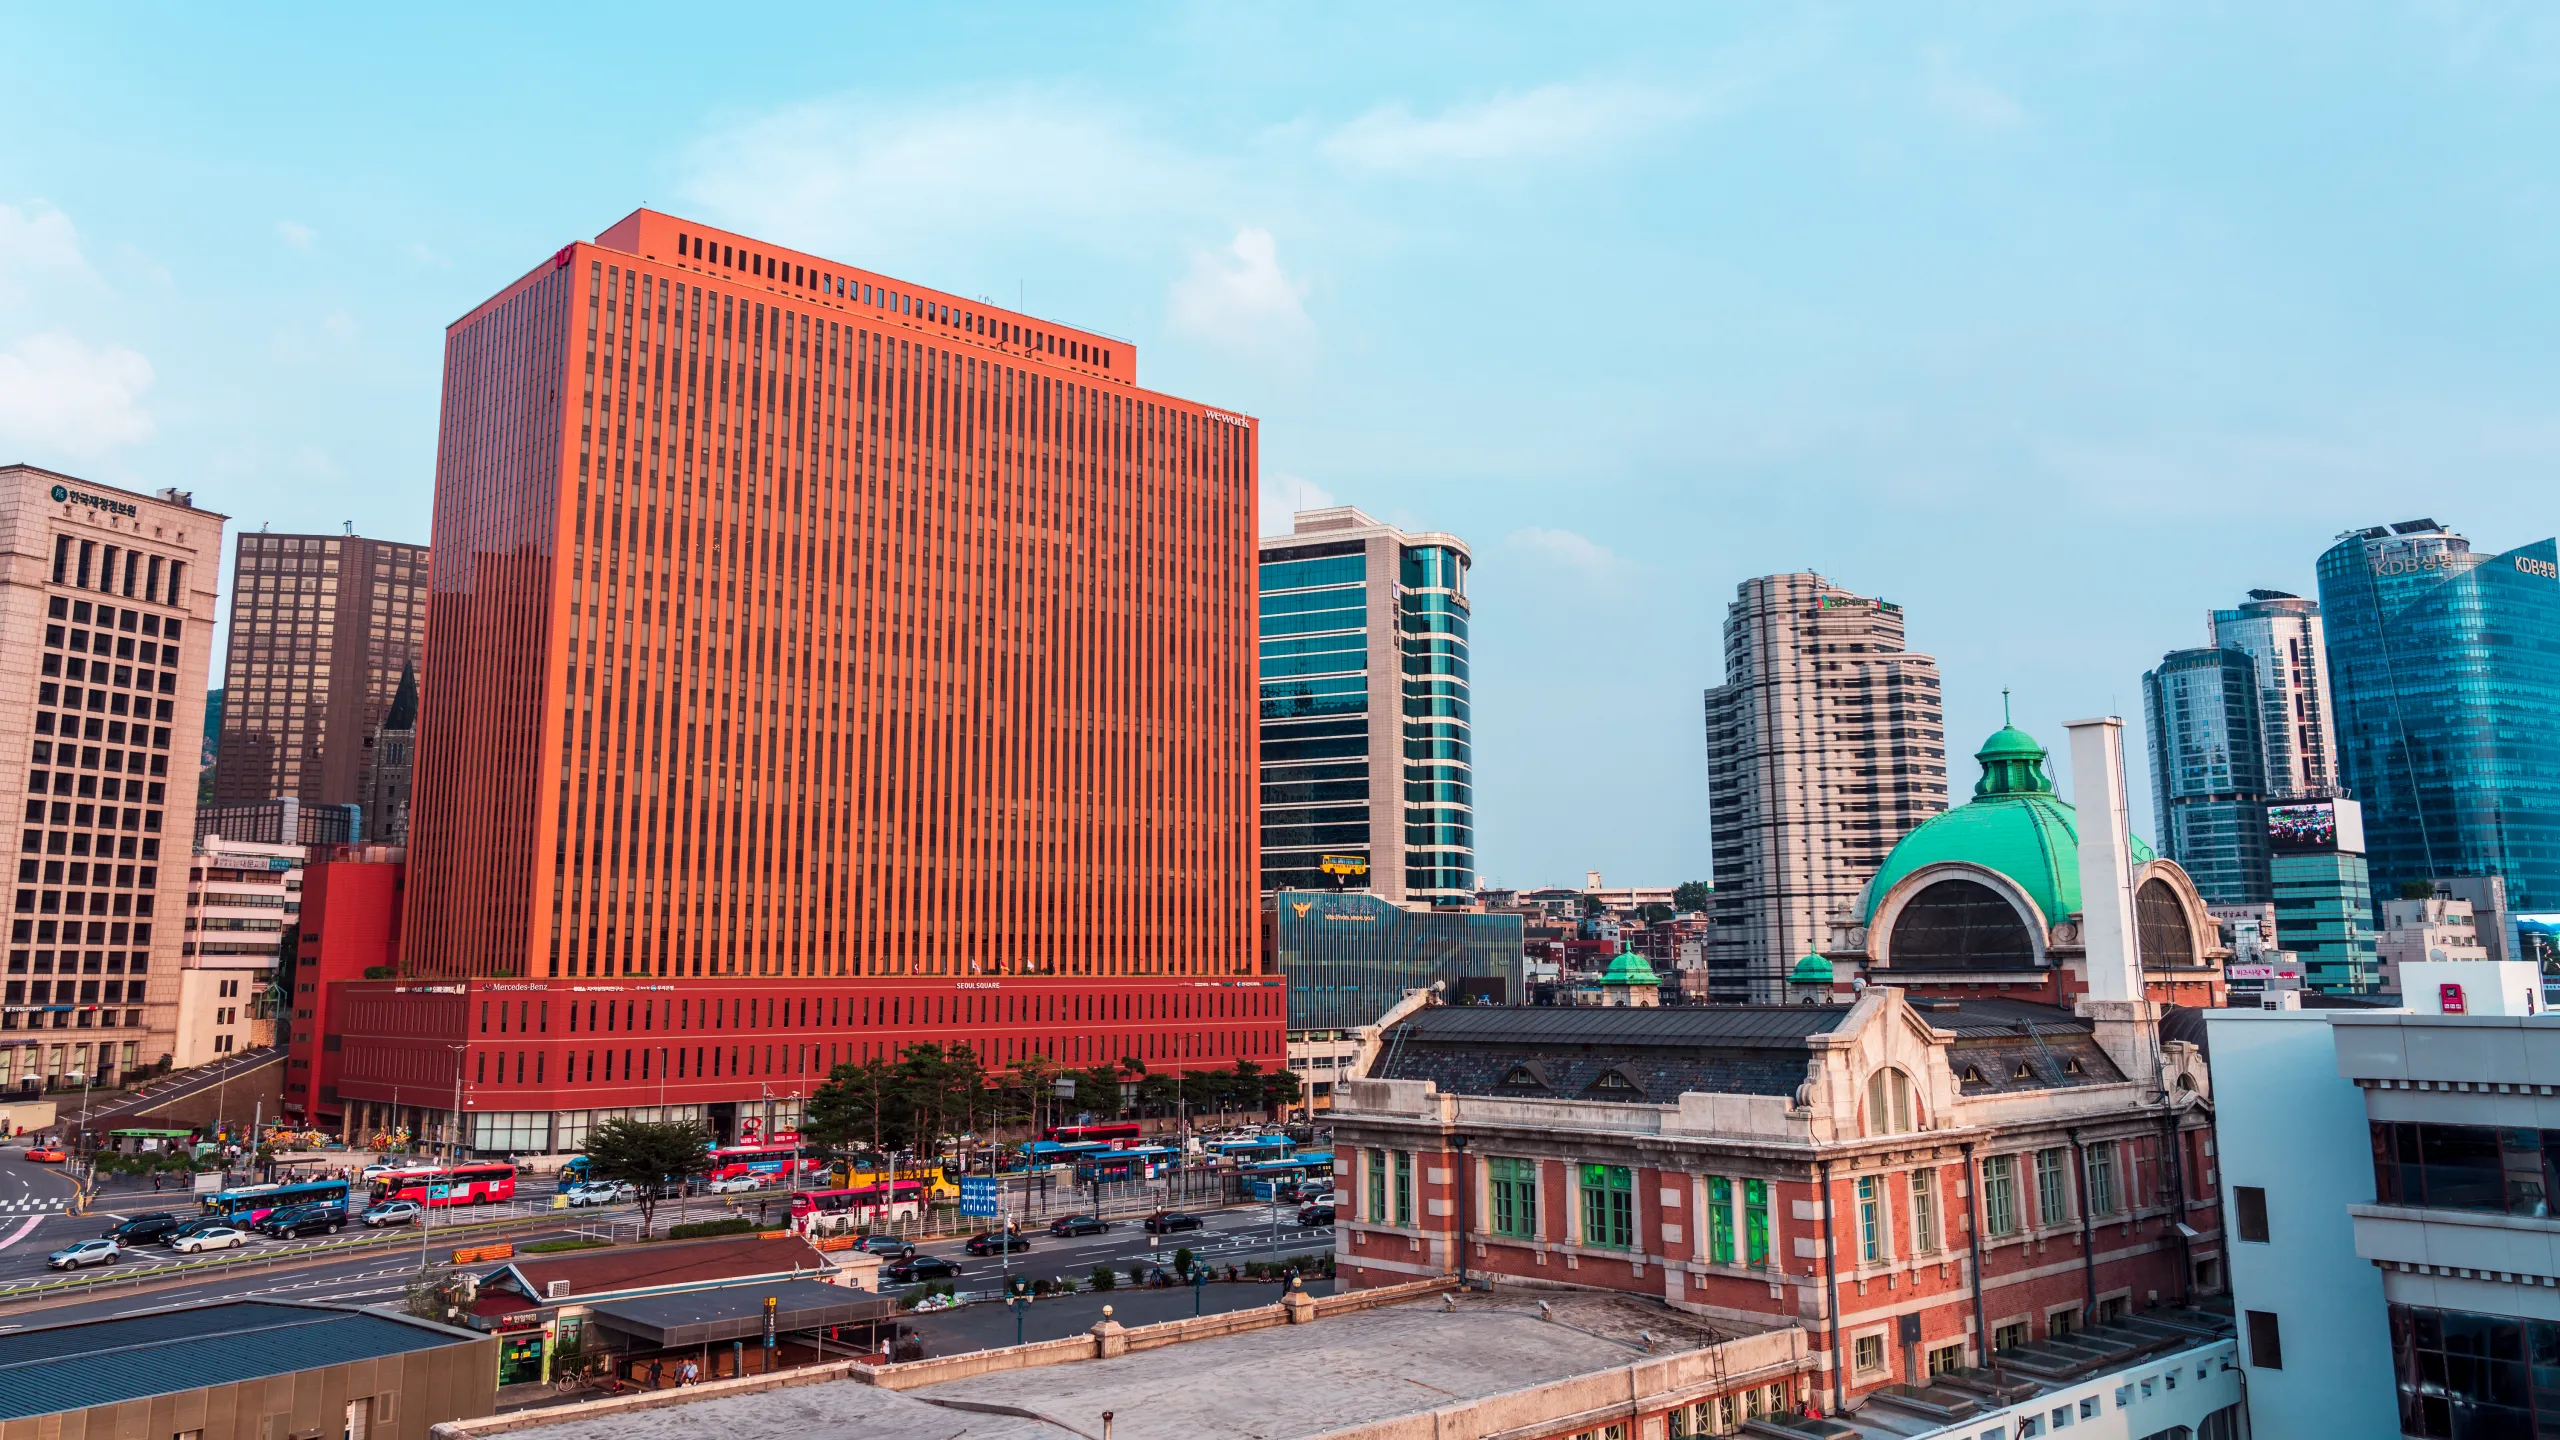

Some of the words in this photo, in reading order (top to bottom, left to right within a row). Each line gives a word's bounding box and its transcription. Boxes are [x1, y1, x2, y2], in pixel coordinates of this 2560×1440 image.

[1204, 410, 1250, 428] wework
[69, 490, 137, 518] 한국재정정보원
[2375, 550, 2455, 577] KDB생명
[2514, 555, 2556, 579] KDB생명
[493, 982, 548, 991] Mercedes-Benz
[560, 1323, 579, 1340] 급구
